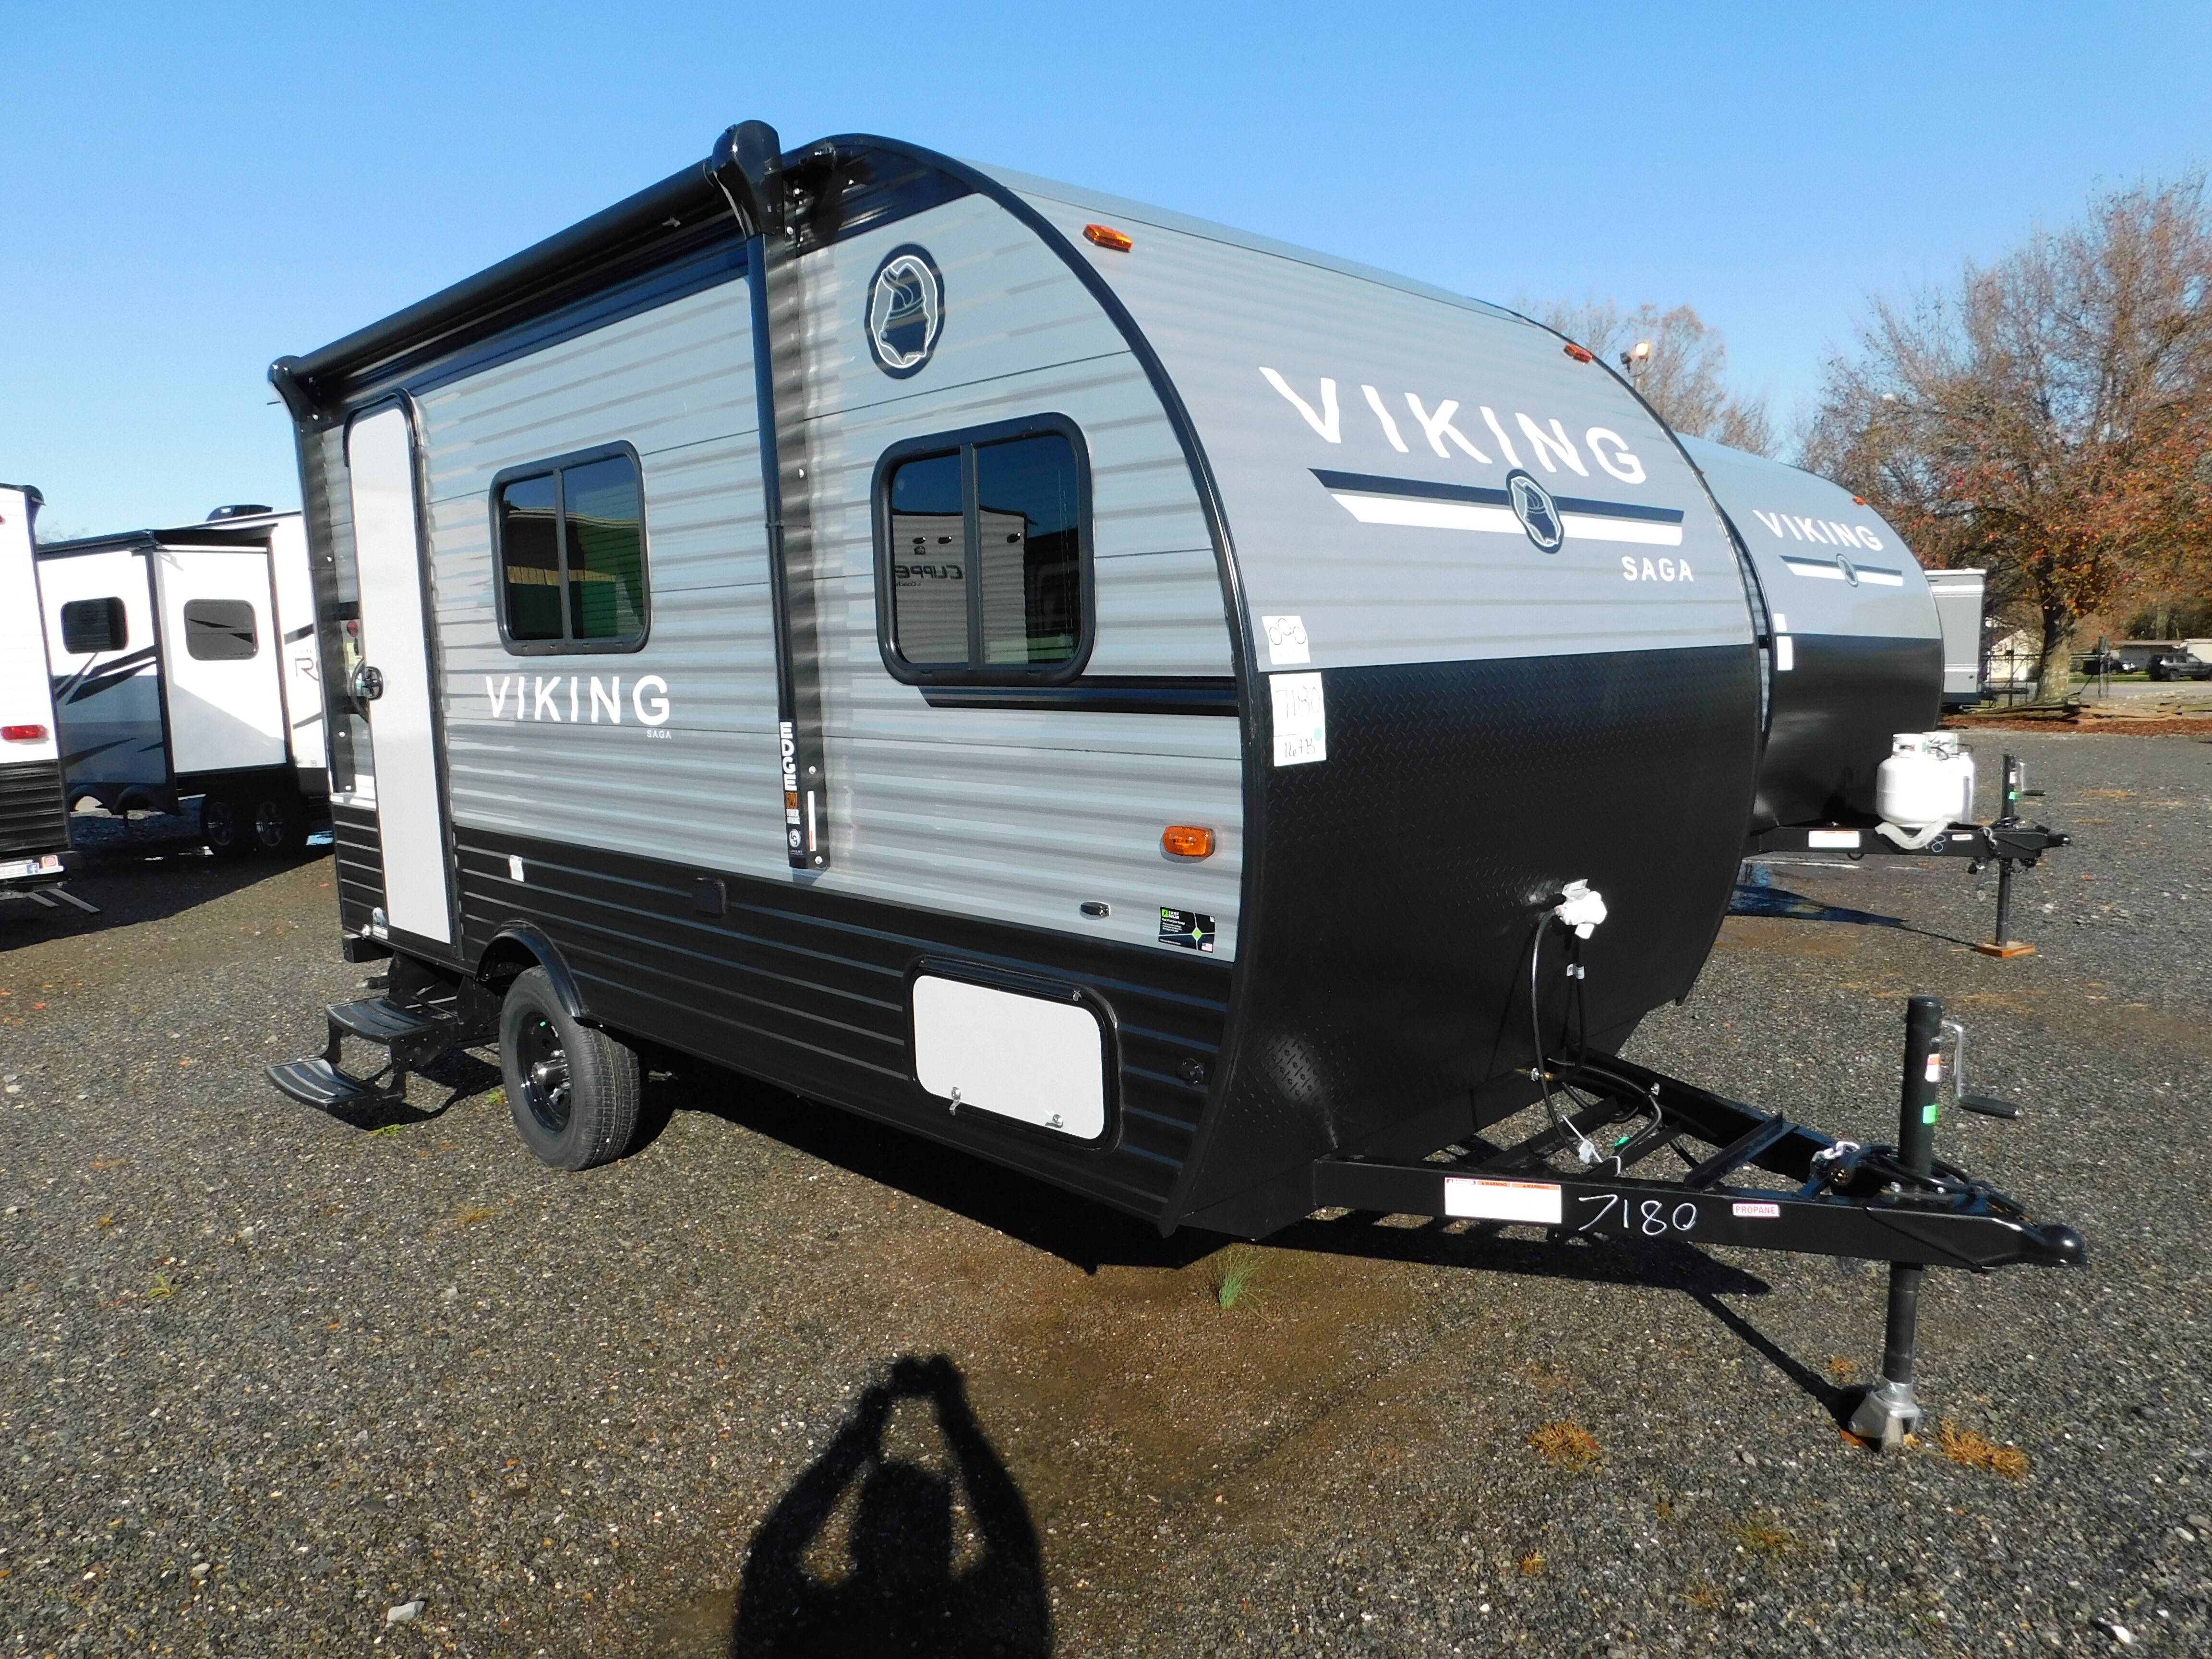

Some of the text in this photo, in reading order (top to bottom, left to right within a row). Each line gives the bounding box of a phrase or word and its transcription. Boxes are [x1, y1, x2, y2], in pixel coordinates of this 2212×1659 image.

[1258, 366, 1647, 484] VIKING
[1752, 509, 1884, 551] VIKING
[1622, 556, 1694, 582] SAGA
[295, 658, 319, 681] R
[485, 675, 670, 726] VIKING
[1276, 685, 1321, 719] 7180
[647, 730, 672, 739] SAGA
[779, 721, 798, 791] EDGE
[1578, 1194, 1697, 1235] 7180
[1735, 1206, 1776, 1214] PROPANE
